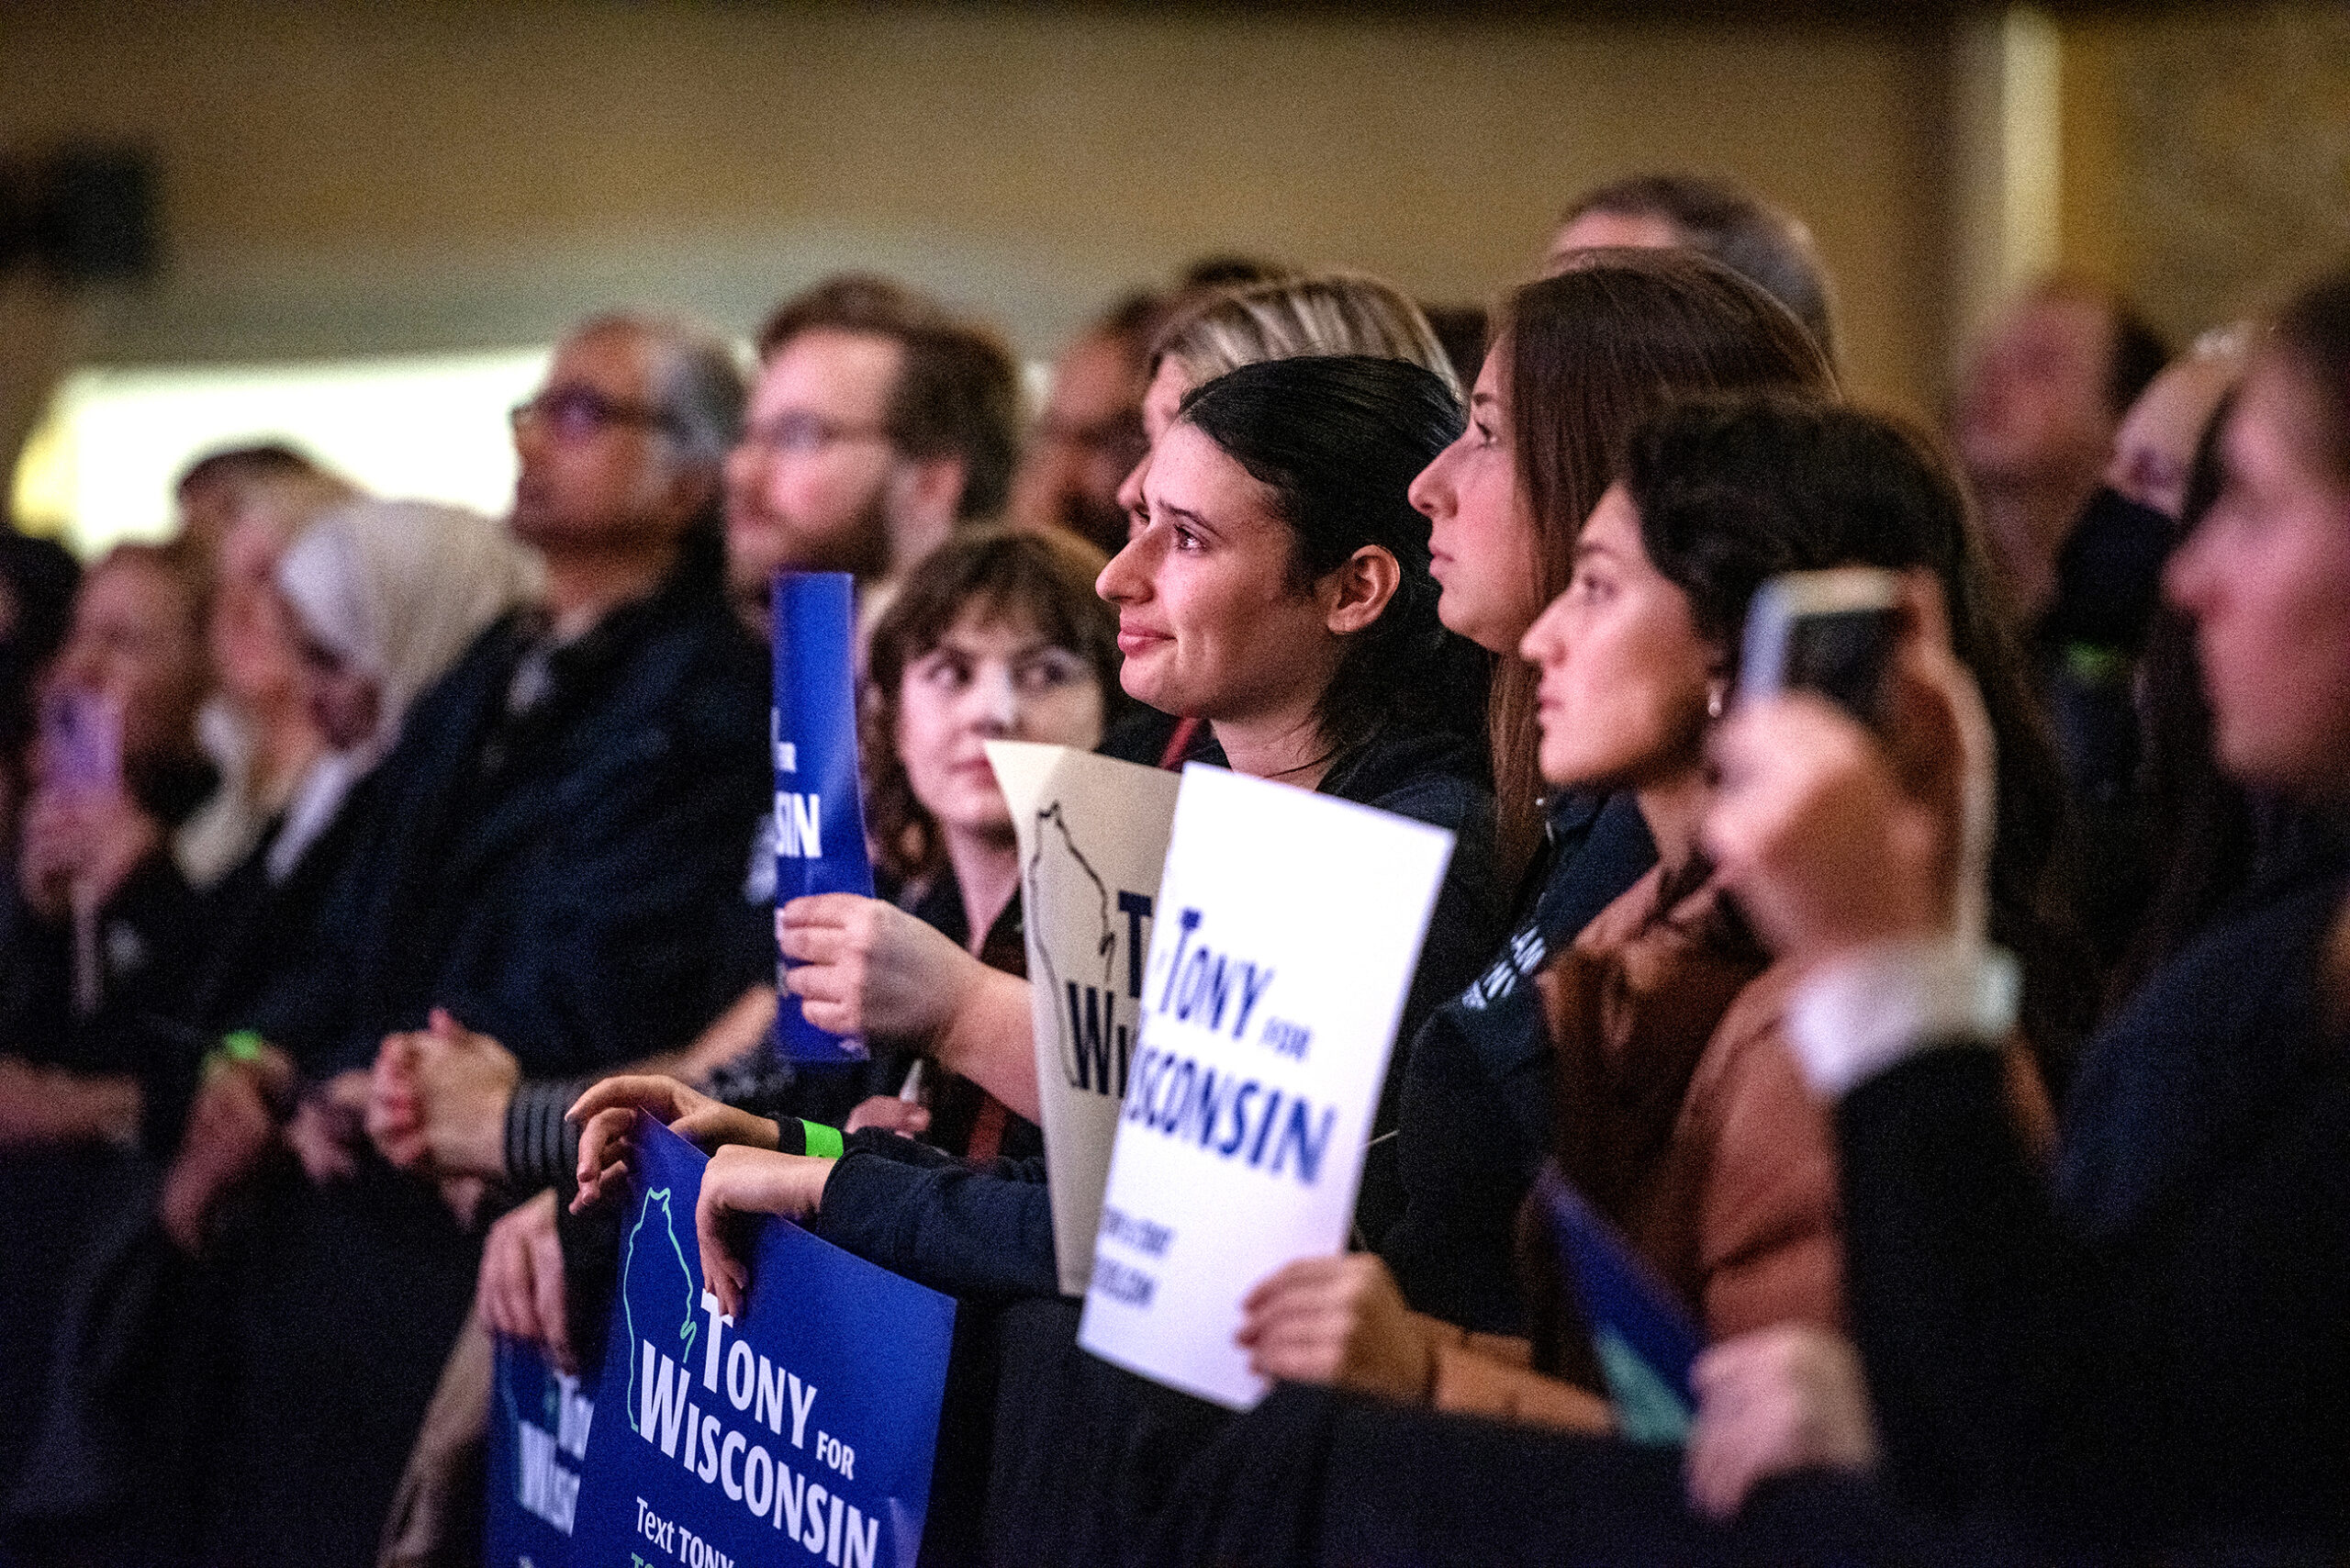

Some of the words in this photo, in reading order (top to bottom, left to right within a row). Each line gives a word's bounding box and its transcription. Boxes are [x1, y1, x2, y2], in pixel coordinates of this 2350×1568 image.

[640, 1338, 878, 1568] WISCONSIN
[700, 1288, 817, 1450] TONY
[816, 1430, 856, 1481] FOR
[636, 1495, 675, 1554] Text
